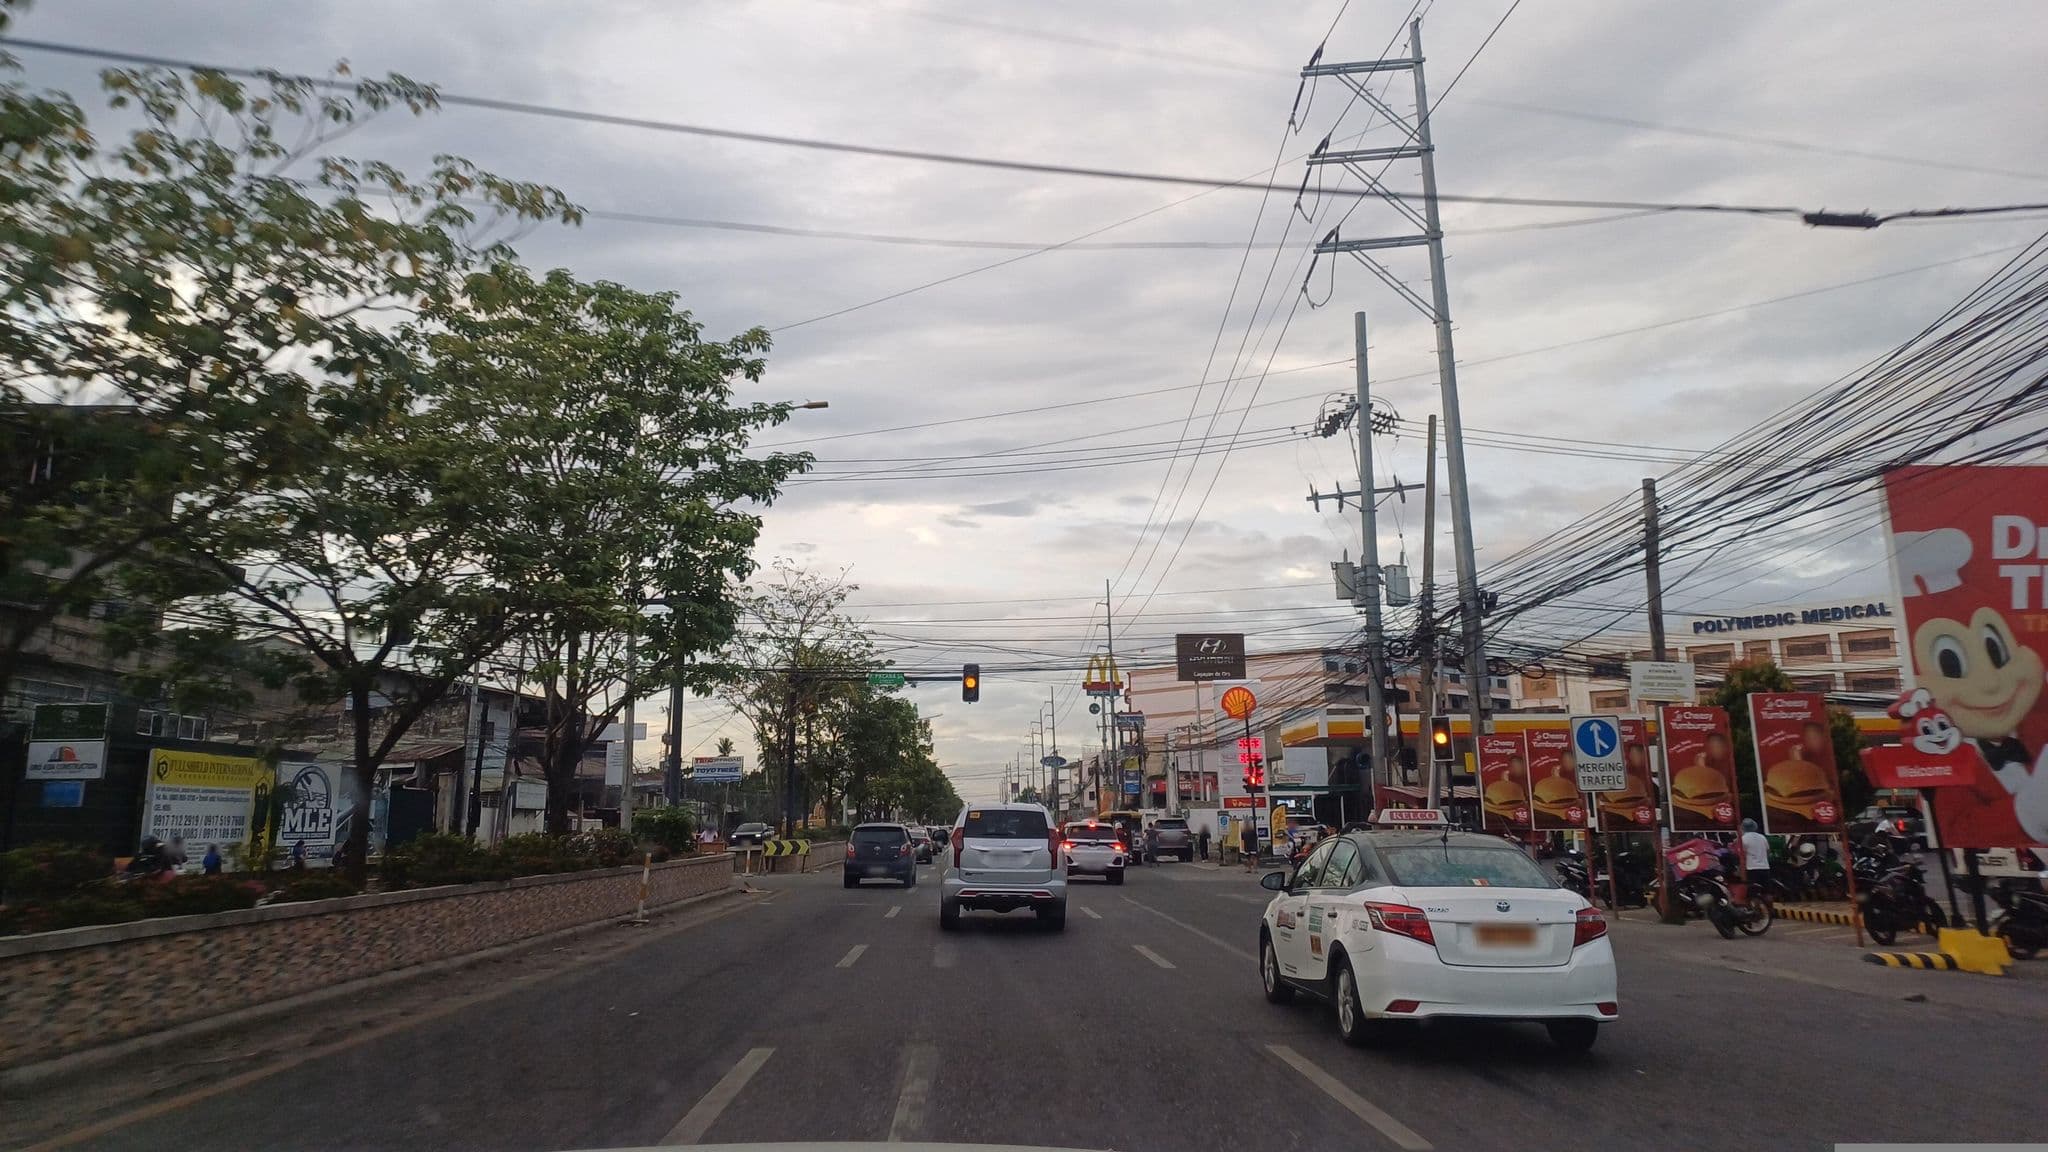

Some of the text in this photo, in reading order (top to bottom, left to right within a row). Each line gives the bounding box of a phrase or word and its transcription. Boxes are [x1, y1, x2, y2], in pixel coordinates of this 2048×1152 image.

[1692, 602, 1892, 634] POLYMEDIC MEDICAL
[1578, 762, 1623, 773] MERGING
[1896, 764, 1952, 778] Welcome
[1581, 775, 1623, 785] TRAFFIC
[284, 808, 331, 833] MLE
[1392, 812, 1435, 820] KELCO
